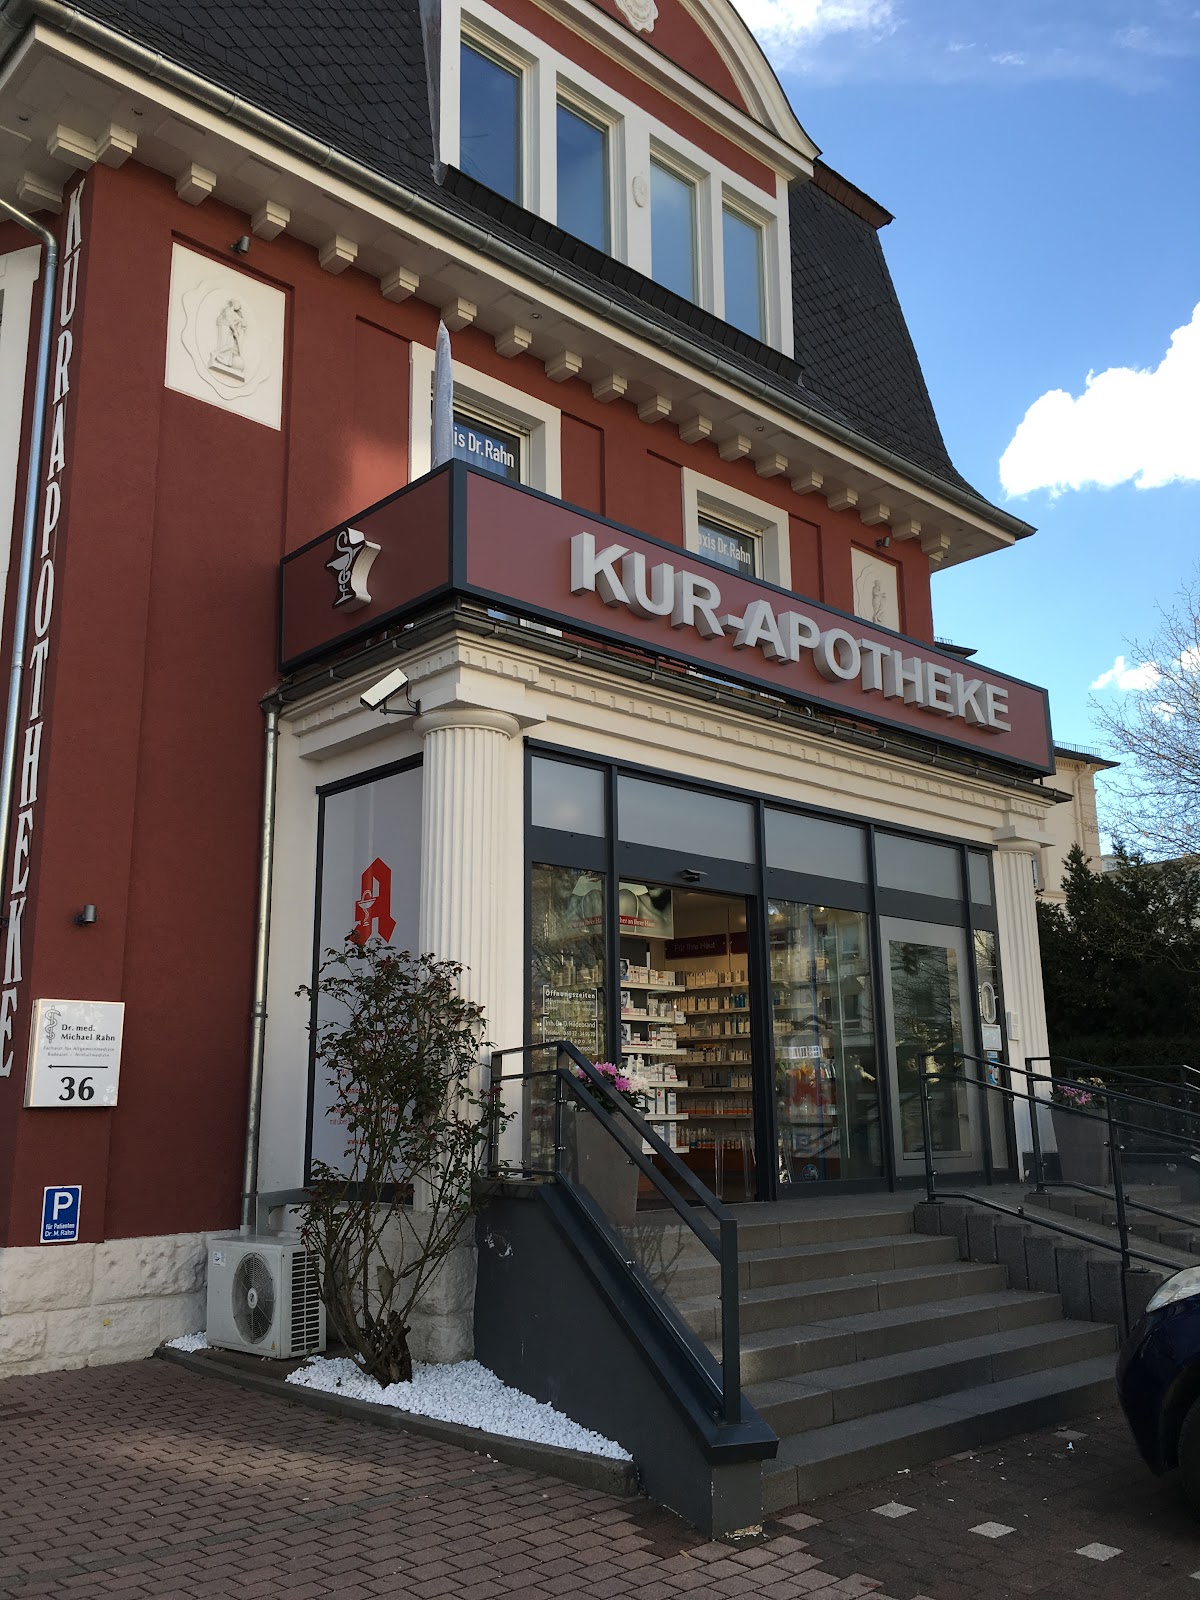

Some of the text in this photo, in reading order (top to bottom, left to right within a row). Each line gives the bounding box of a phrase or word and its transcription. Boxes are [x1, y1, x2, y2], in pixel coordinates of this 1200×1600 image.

[485, 439, 515, 468] Rahn
[698, 532, 716, 551] axis
[730, 541, 751, 565] Rahn
[570, 531, 1012, 734] KUR-APOTHEKE
[545, 989, 596, 999] Öffnungszeiten
[61, 1033, 93, 1041] Michael
[58, 1076, 95, 1101] 36
[53, 1192, 73, 1220] P
